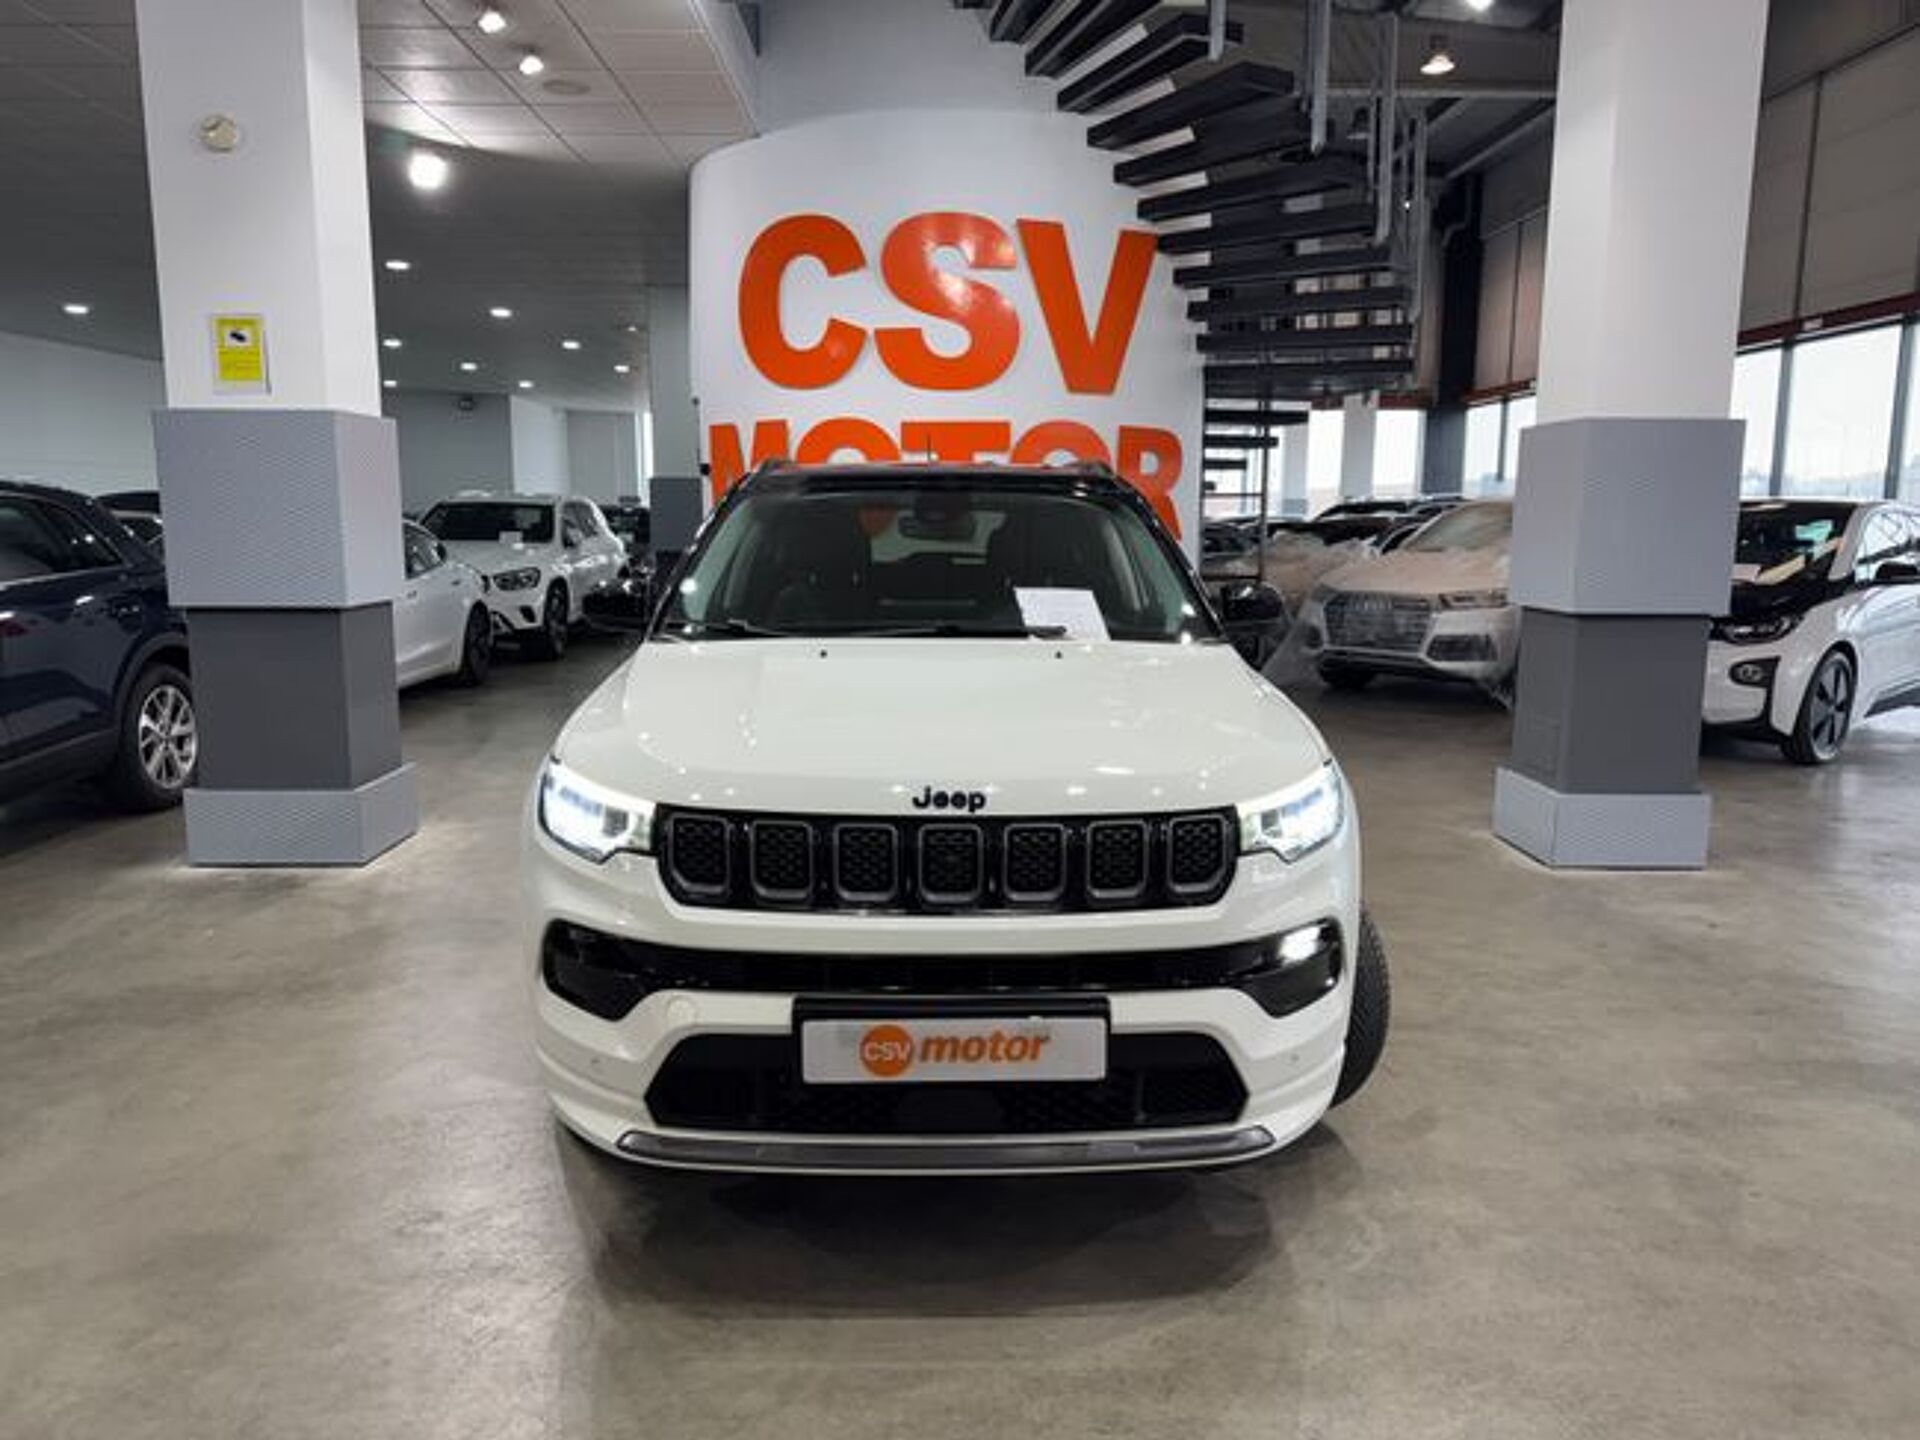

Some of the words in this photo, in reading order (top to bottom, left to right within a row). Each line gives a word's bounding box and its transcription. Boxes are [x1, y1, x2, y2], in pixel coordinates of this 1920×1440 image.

[738, 212, 1158, 395] CSV
[912, 785, 986, 813] Jeep
[921, 1030, 1050, 1063] motor
